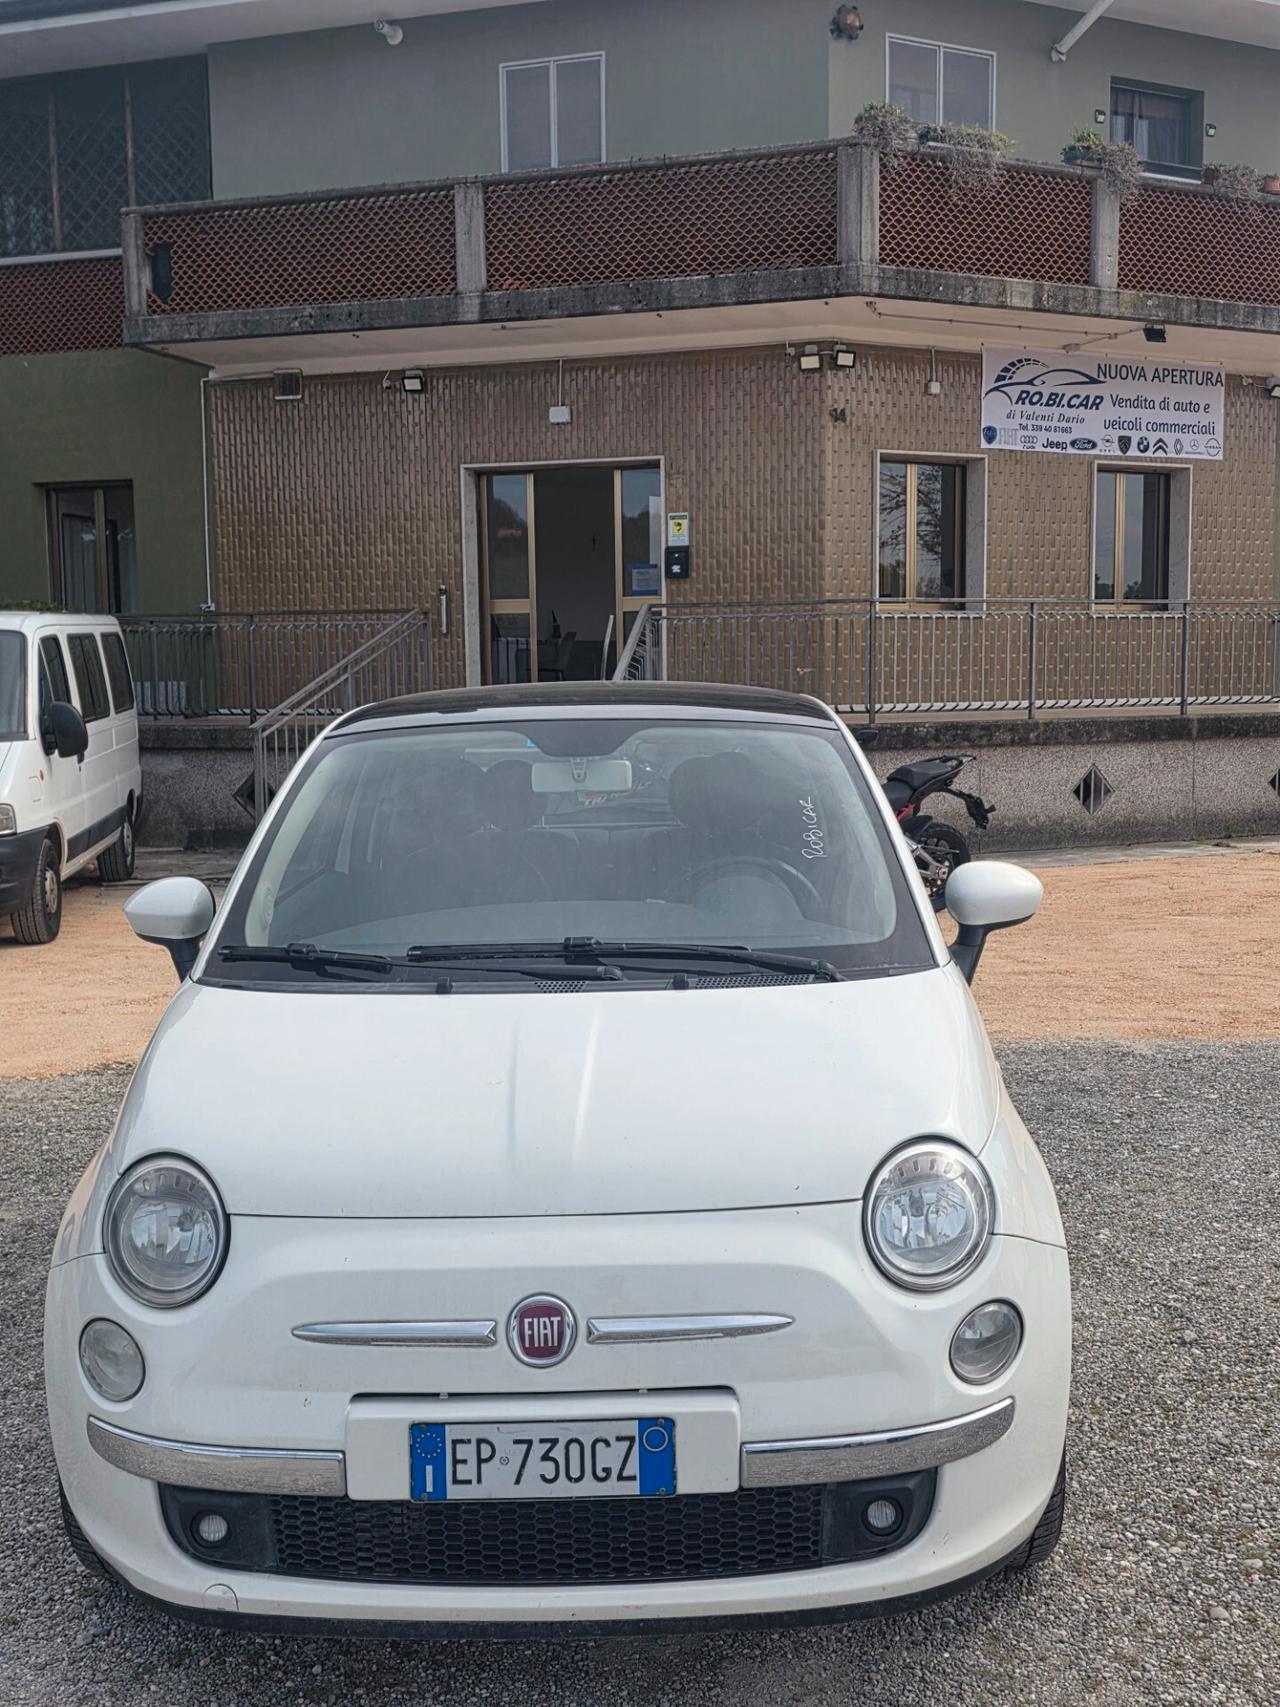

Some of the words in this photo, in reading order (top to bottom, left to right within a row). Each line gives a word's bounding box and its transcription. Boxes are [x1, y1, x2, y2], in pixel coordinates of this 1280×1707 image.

[1097, 363, 1148, 382] NUOVA
[1151, 367, 1224, 387] APERTURA
[1015, 390, 1104, 410] RO.BI.CAR
[1110, 394, 1156, 410] Vendita
[1159, 397, 1170, 411] di
[1173, 400, 1200, 413] auto
[1203, 403, 1210, 413] e
[1006, 410, 1016, 420] di
[1020, 410, 1055, 422] Valenti
[1057, 412, 1085, 424] Dario
[1103, 416, 1142, 431] veicoli
[1145, 420, 1216, 436] commerciali
[1044, 425, 1052, 433] 40
[1042, 438, 1068, 451] Jeep
[524, 1316, 561, 1348] FIAT
